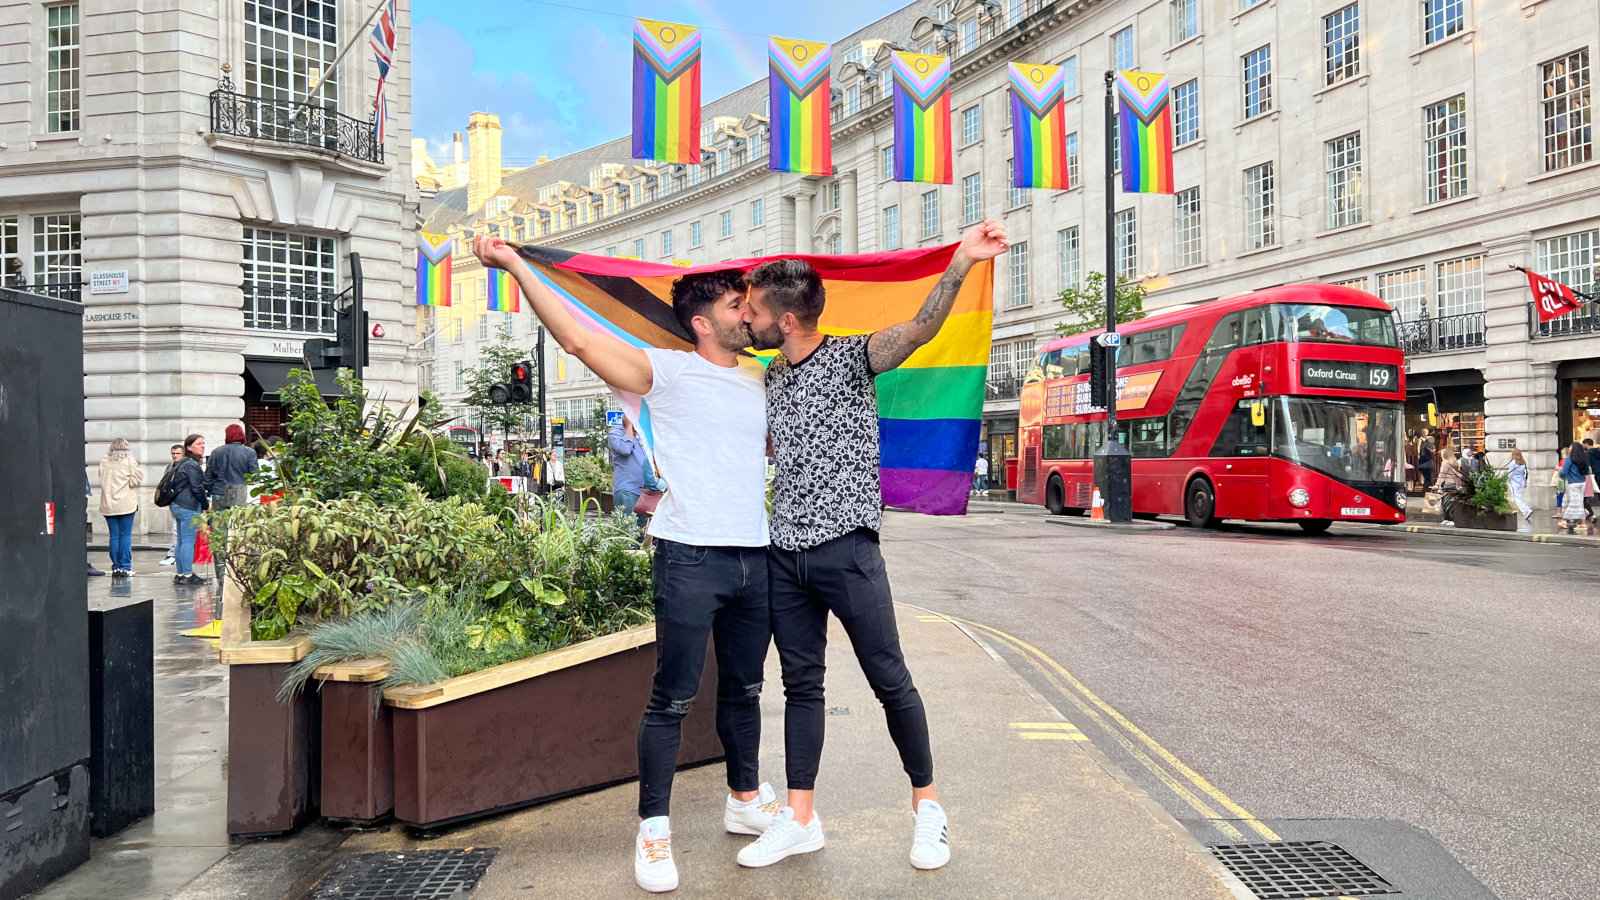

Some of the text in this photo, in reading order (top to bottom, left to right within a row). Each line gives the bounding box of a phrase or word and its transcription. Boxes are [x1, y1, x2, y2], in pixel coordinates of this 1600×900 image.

[93, 279, 111, 287] STREET
[86, 312, 122, 321] LASSHOUSE
[272, 342, 304, 354] Mulber
[1307, 367, 1389, 386] Oxford Circus 159
